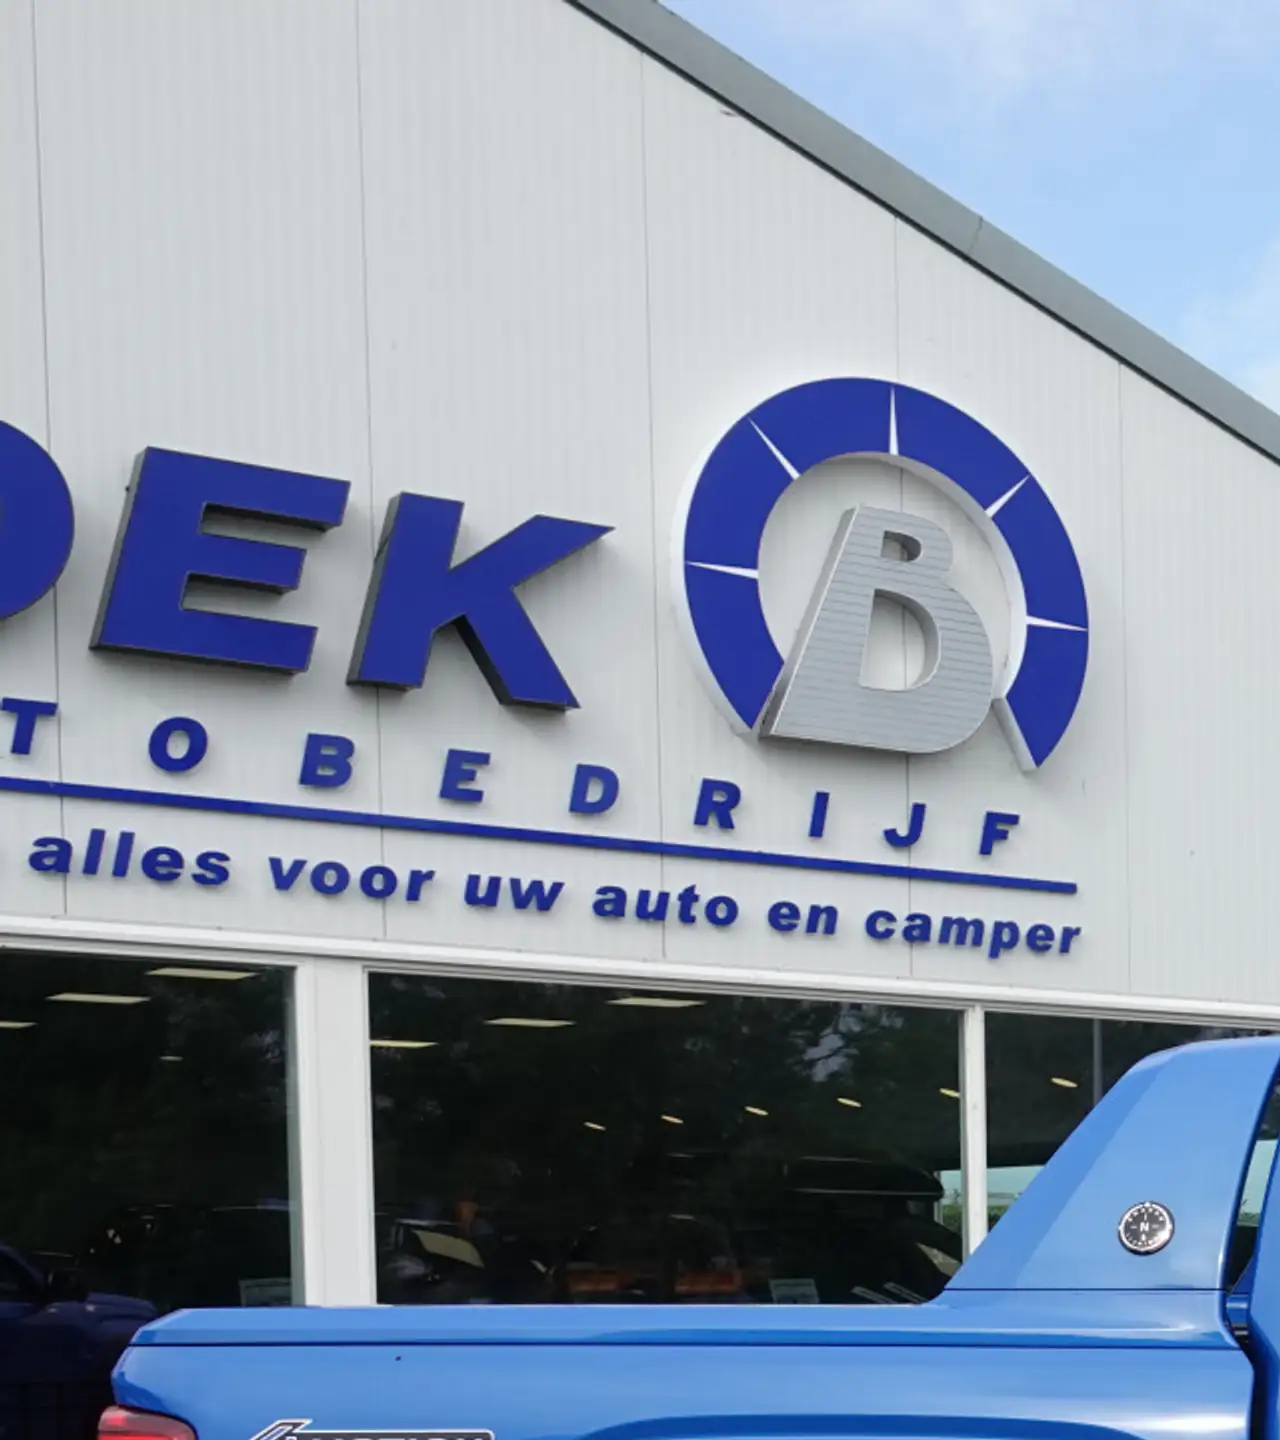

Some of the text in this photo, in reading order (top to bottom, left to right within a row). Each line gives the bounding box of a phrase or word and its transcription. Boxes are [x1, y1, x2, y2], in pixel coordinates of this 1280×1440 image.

[28, 828, 1082, 959] alles voor uw auto en camper
